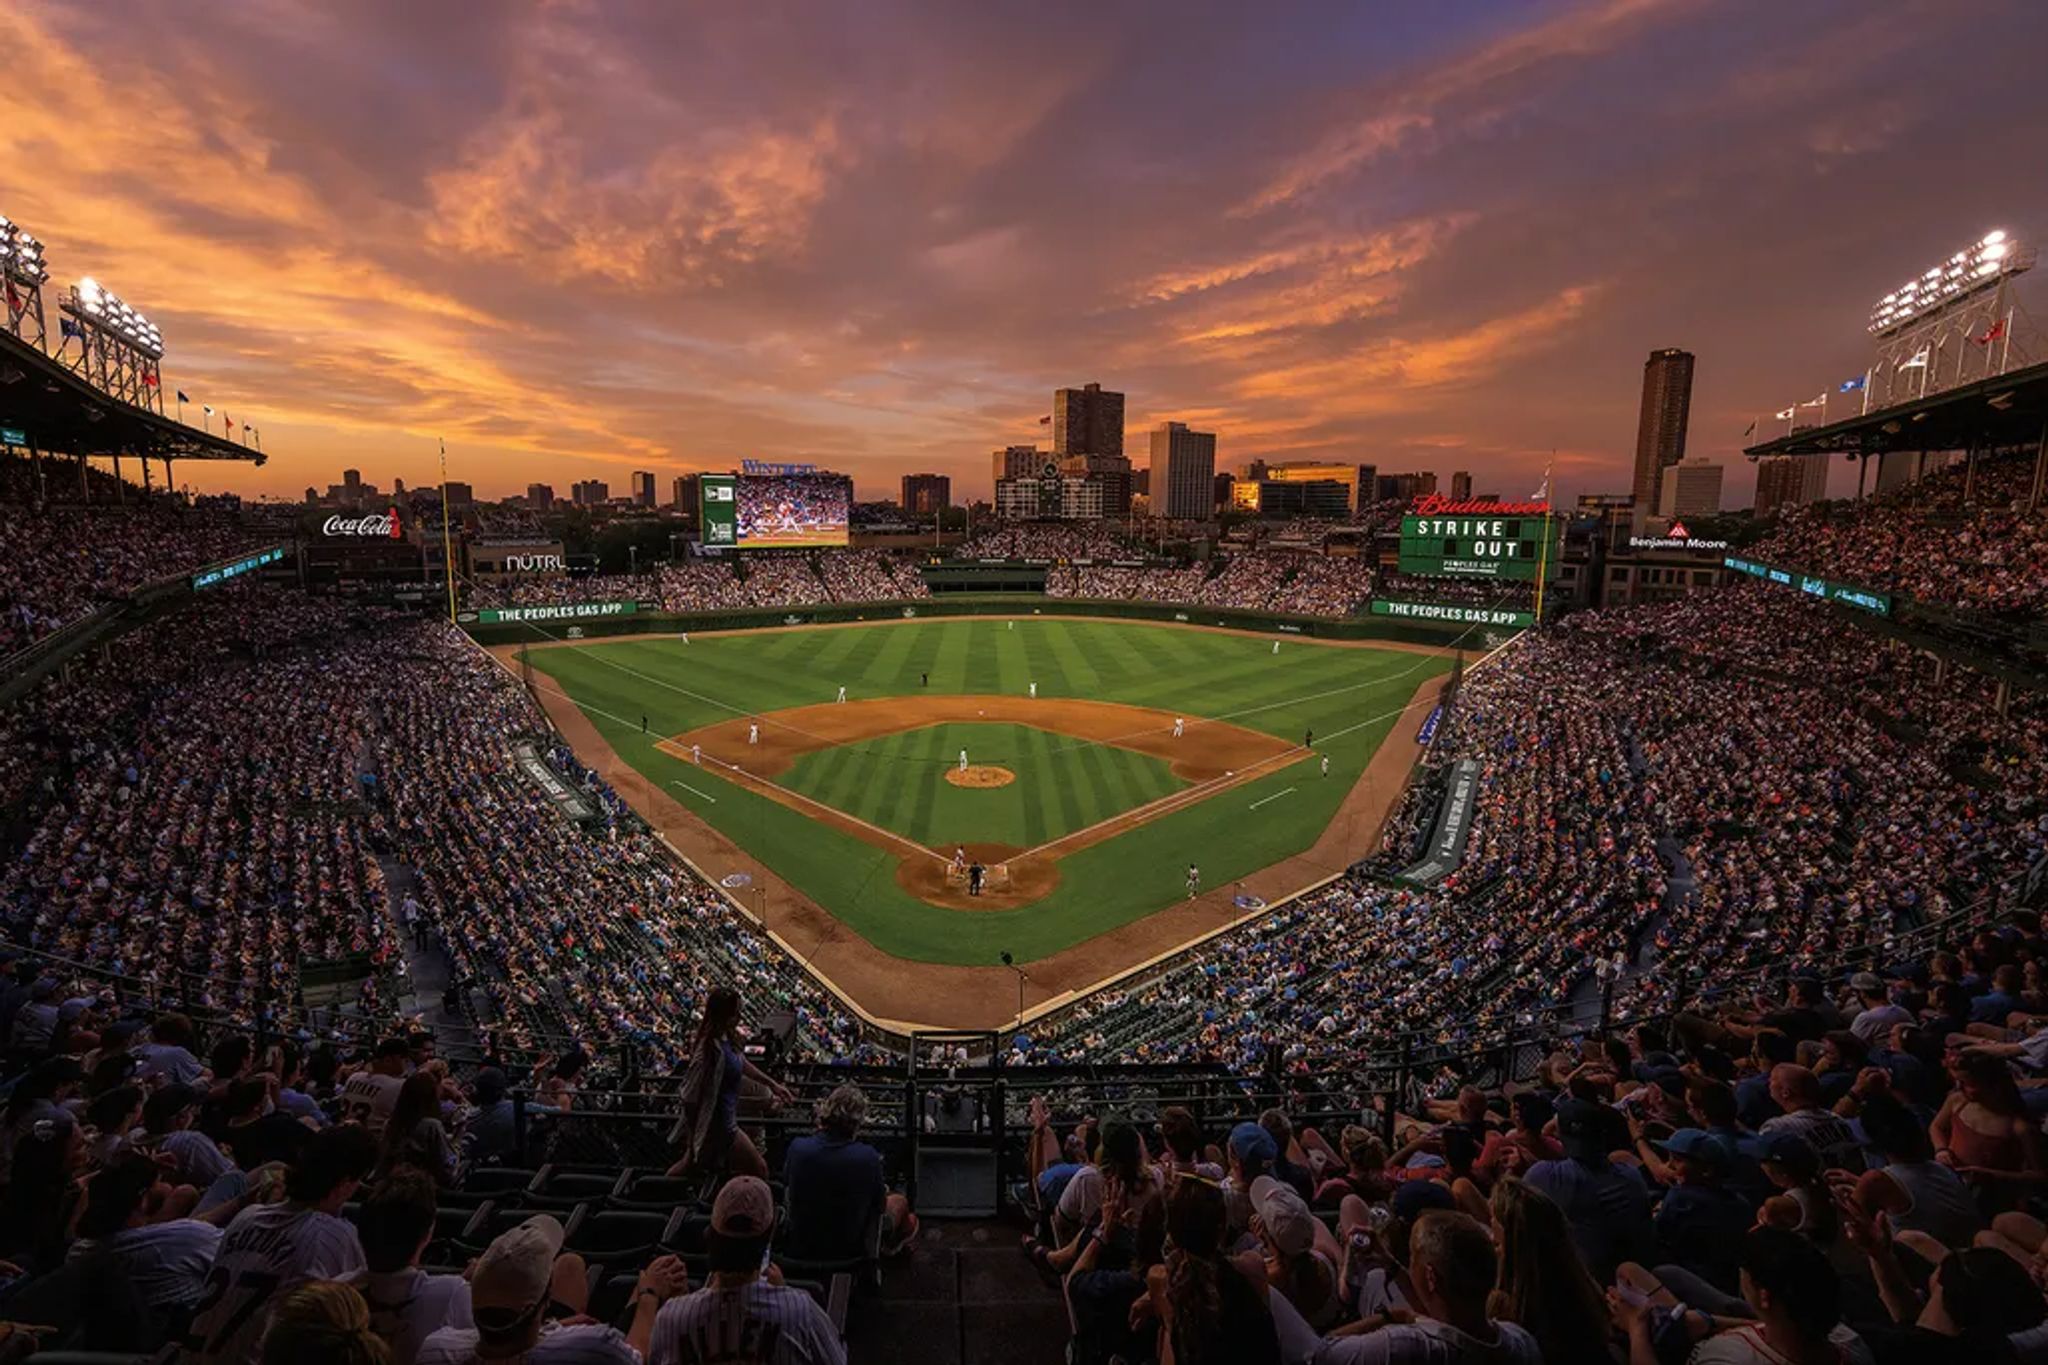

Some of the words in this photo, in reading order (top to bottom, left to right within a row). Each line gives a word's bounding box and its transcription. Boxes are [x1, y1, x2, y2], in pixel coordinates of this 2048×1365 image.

[1413, 494, 1550, 515] Budweiser
[323, 514, 392, 536] Coca-Cola
[1417, 520, 1503, 536] STRIKE
[1474, 541, 1517, 556] OUT
[1629, 537, 1684, 549] Benjamin
[1687, 539, 1727, 548] Moore
[498, 610, 521, 621] THE
[524, 606, 574, 620] PEOPLES
[577, 605, 598, 617] GAS
[602, 603, 622, 614] APP
[1388, 603, 1409, 615] THE
[1412, 604, 1462, 620] PEOPLES
[1464, 609, 1489, 622] GAS
[1491, 611, 1517, 624] APP
